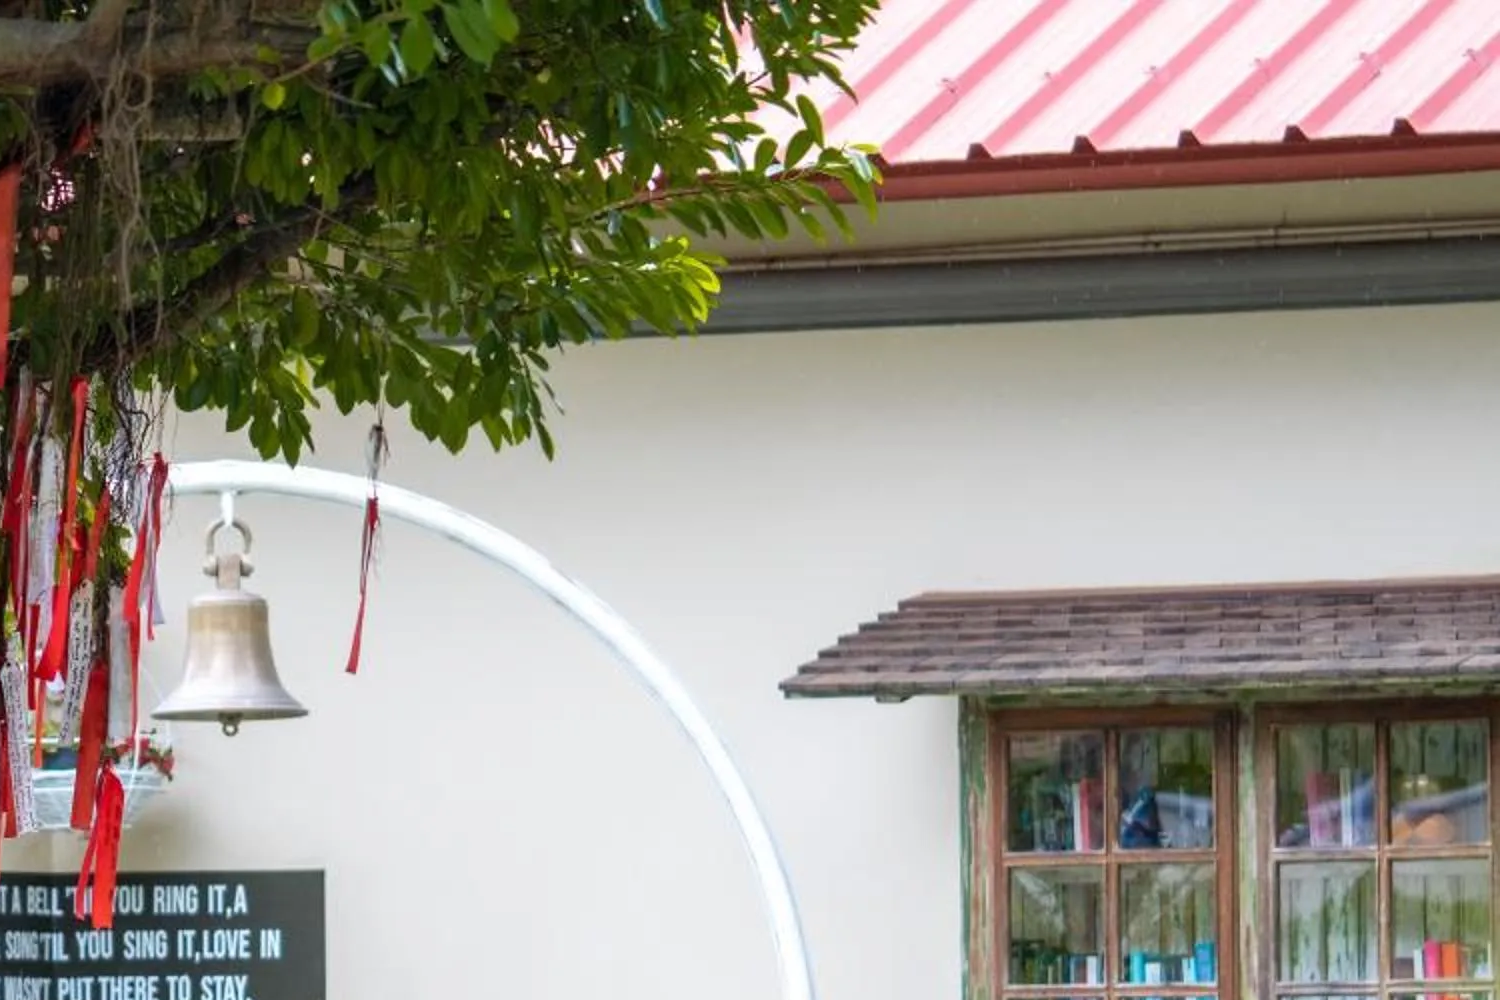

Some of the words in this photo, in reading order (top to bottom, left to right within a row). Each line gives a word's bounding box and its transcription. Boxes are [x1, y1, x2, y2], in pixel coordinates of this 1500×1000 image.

[11, 886, 22, 915] A
[27, 886, 64, 917] BELL
[153, 885, 199, 915] RING
[4, 930, 40, 961] SONG
[75, 928, 114, 960] YOU
[123, 930, 169, 960] SING
[259, 929, 282, 960] IN
